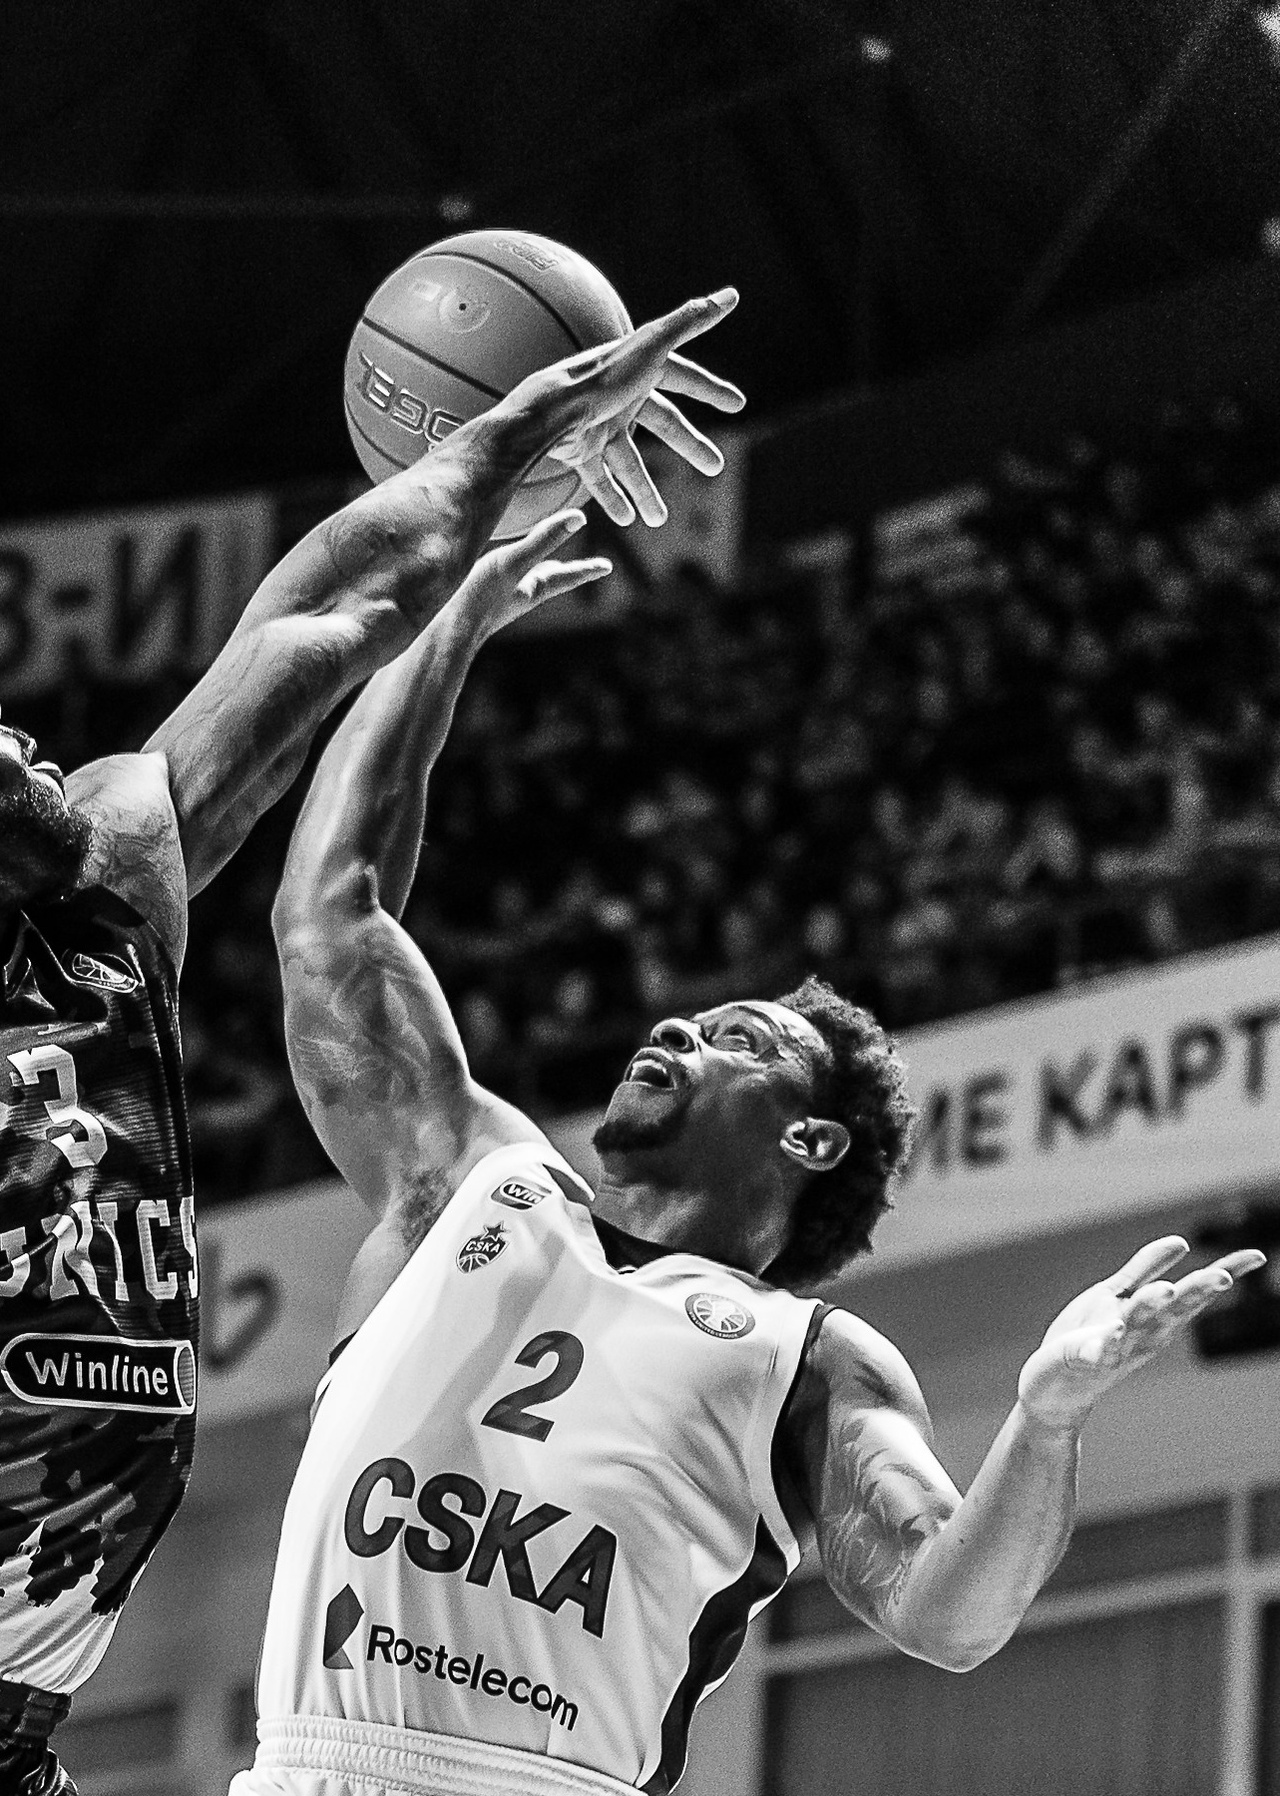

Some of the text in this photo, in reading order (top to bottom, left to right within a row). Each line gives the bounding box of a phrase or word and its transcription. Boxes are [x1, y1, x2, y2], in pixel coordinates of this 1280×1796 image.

[7, 1043, 108, 1168] 3
[465, 1240, 501, 1253] CSKA
[24, 1351, 169, 1396] Winline
[480, 1330, 585, 1443] 2
[343, 1457, 618, 1640] CSKA
[365, 1624, 580, 1732] Rostelecom
